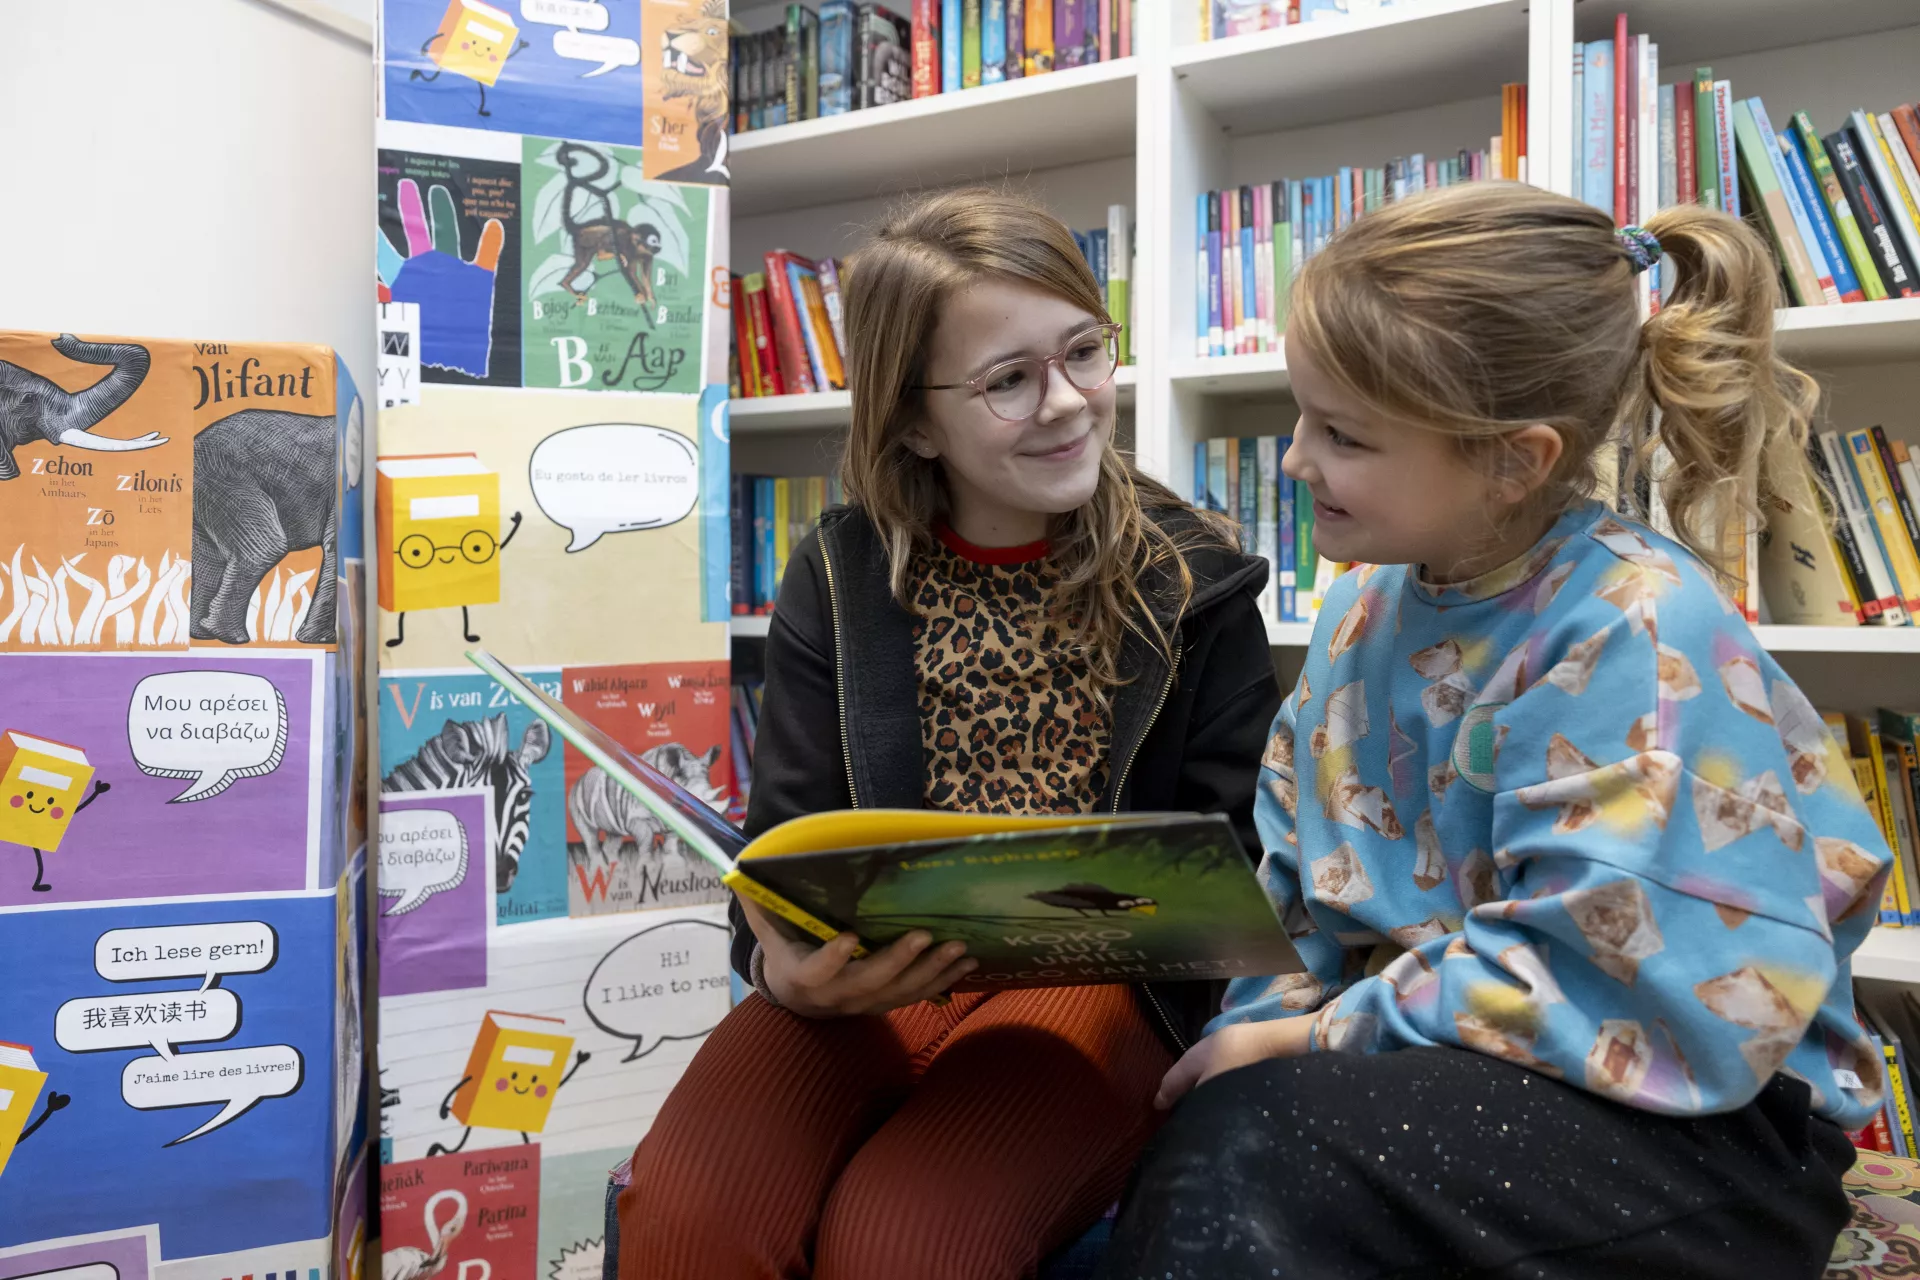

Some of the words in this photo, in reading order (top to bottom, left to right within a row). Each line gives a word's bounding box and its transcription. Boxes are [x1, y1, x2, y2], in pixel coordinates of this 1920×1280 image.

[650, 115, 688, 135] Sher
[194, 342, 228, 356] van
[550, 336, 593, 388] B
[602, 331, 685, 391] Aap
[49, 478, 59, 487] in
[61, 478, 75, 487] het
[535, 469, 552, 481] Eu
[556, 471, 595, 483] gosto
[598, 471, 614, 482] de
[618, 471, 640, 483] ler
[644, 471, 688, 484] livros
[37, 487, 87, 498] Amhaars
[138, 495, 147, 503] in
[149, 495, 163, 504] het
[89, 528, 98, 537] in
[100, 528, 115, 537] het
[84, 537, 119, 549] Japans
[144, 695, 192, 711] Μου
[199, 693, 269, 716] αρέσει
[387, 682, 427, 729] V
[430, 690, 444, 710] is
[447, 691, 482, 707] van
[146, 727, 173, 740] να
[180, 722, 270, 744] διαβάζω
[400, 826, 453, 844] αρέσει
[388, 848, 455, 867] διαβάζω
[575, 861, 618, 904] W
[619, 878, 629, 890] is
[609, 889, 633, 902] van
[1002, 929, 1133, 947] KOKO
[111, 946, 148, 963] Ich
[154, 945, 202, 961] lese
[208, 939, 264, 961] gern!
[660, 950, 689, 968] Hi!
[964, 969, 1066, 983] COCO
[1077, 963, 1148, 978] KAN
[602, 987, 612, 1004] I
[618, 983, 664, 1002] like
[671, 979, 692, 993] to
[82, 999, 207, 1030] 我喜欢读书
[183, 1069, 215, 1081] lire
[219, 1066, 243, 1078] des
[245, 1060, 295, 1075] livres!
